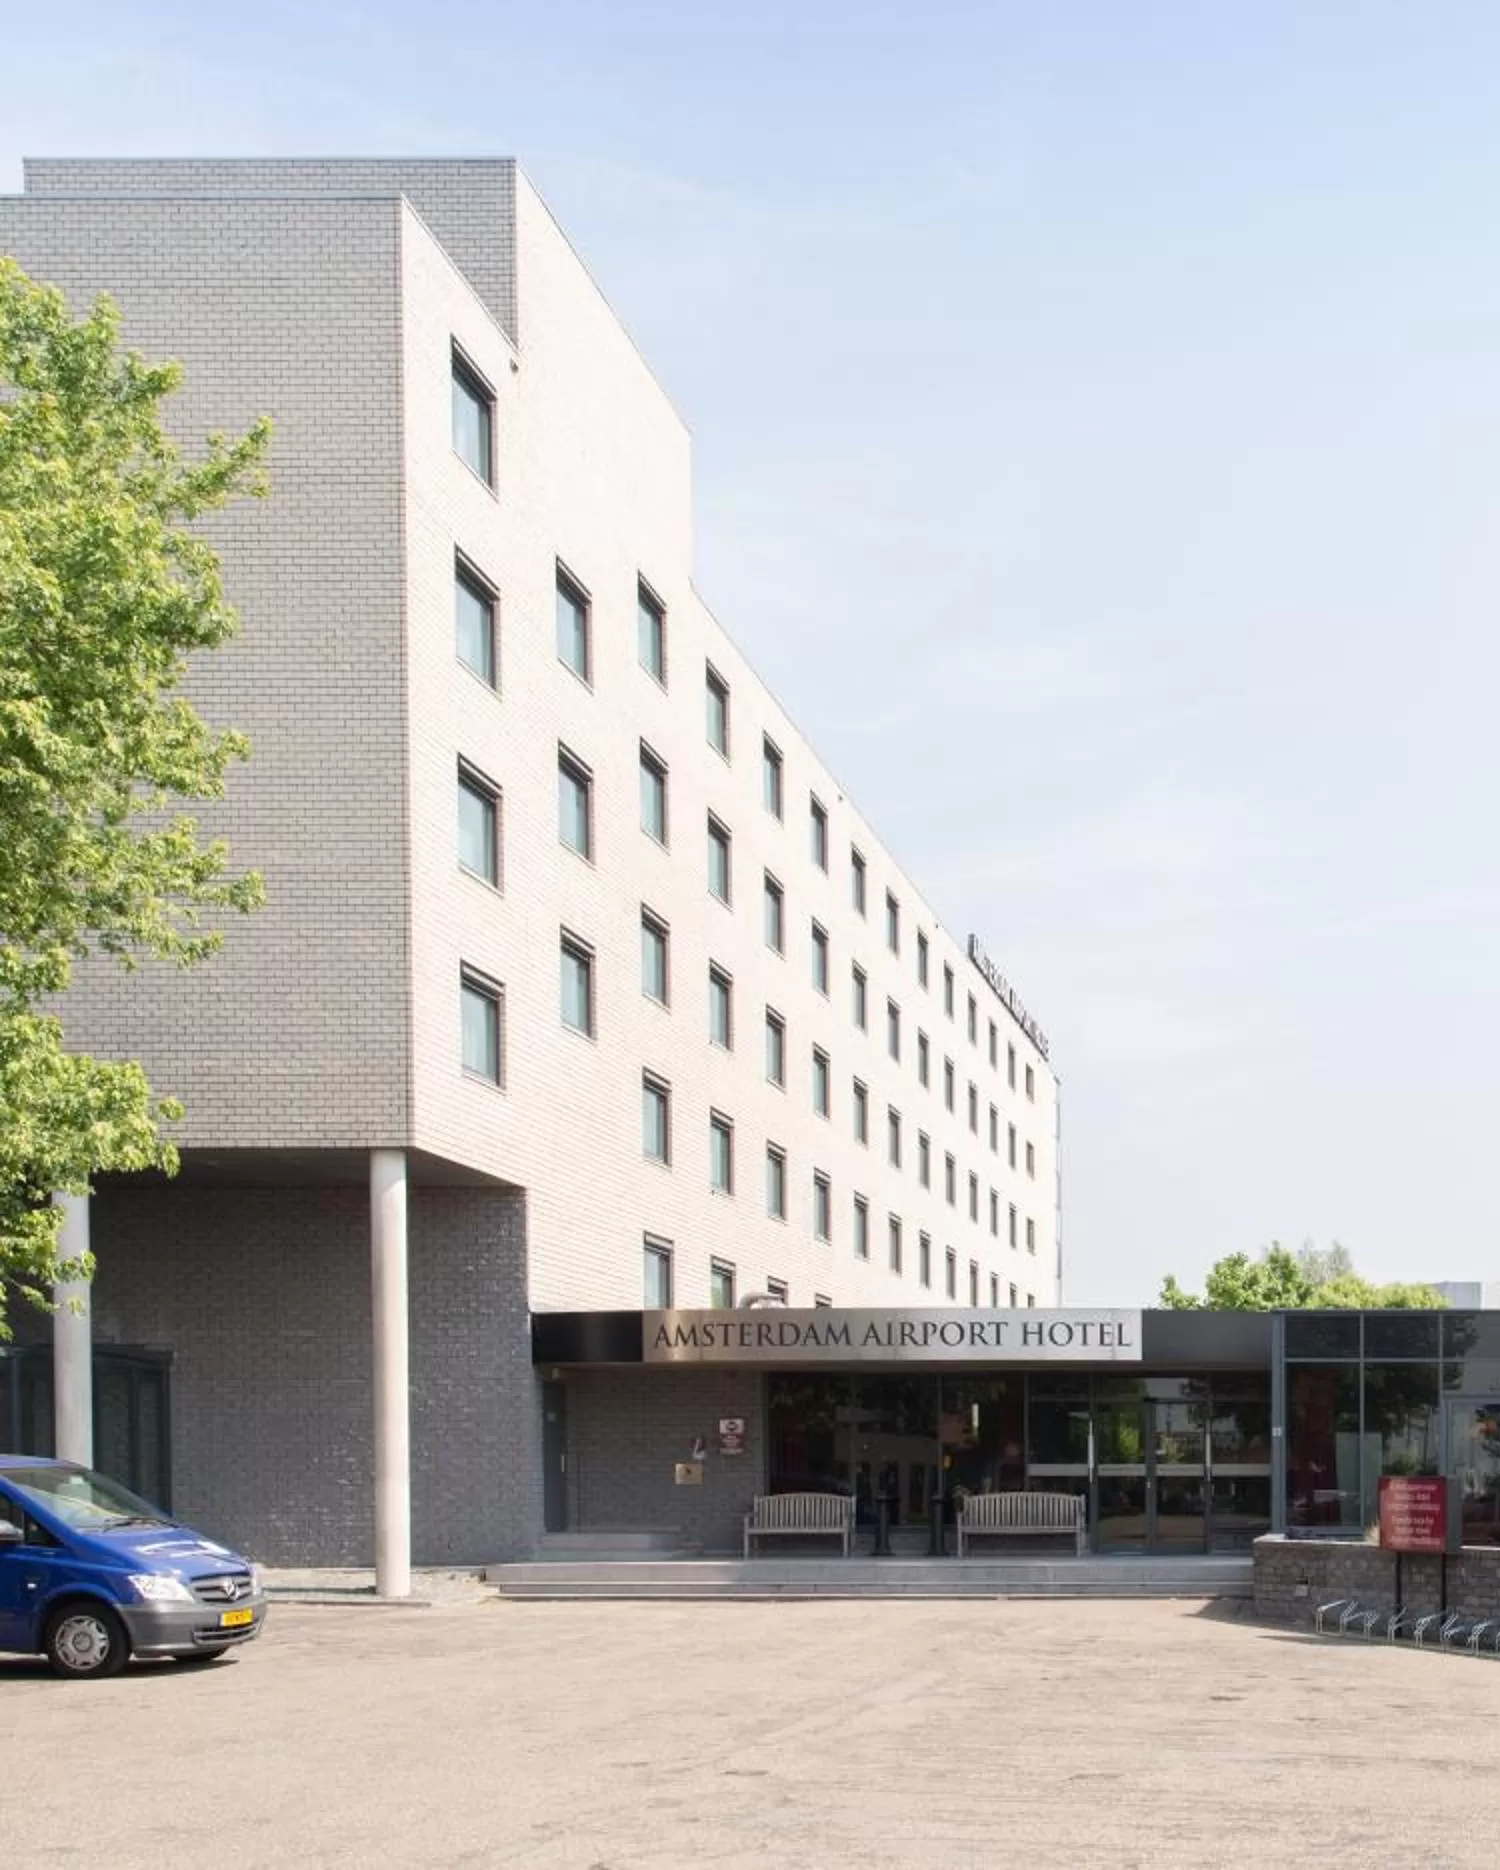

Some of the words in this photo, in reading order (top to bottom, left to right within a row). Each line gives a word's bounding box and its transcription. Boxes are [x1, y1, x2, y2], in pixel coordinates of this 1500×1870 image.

[653, 1320, 852, 1348] AMSTERDAM
[859, 1320, 1009, 1348] AIRPORT
[1020, 1320, 1133, 1348] HOTEL
